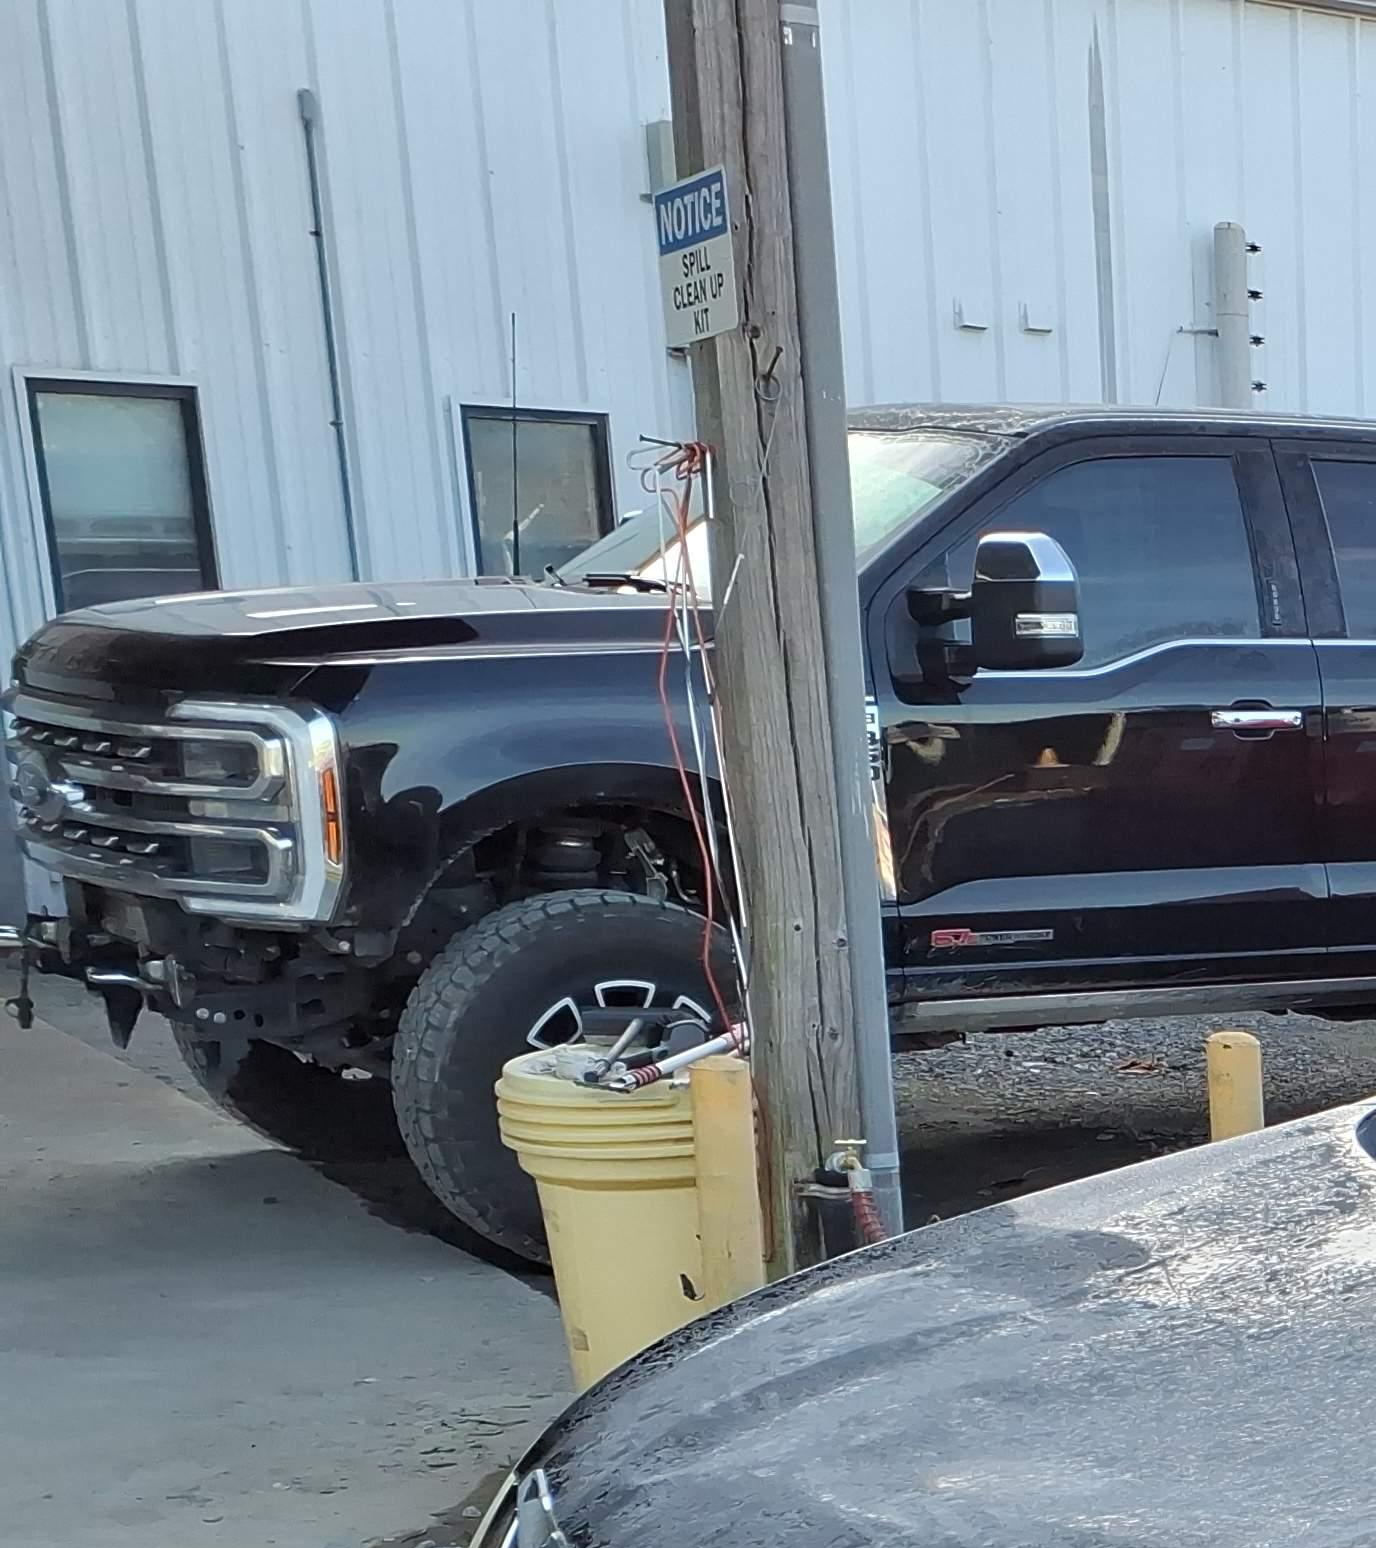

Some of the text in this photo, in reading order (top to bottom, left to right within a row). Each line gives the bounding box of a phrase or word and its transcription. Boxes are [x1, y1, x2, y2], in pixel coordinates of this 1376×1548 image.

[660, 182, 723, 245] NOTICE
[681, 247, 711, 278] SPILL
[672, 272, 725, 311] CLEAN UP
[693, 308, 710, 335] KIT
